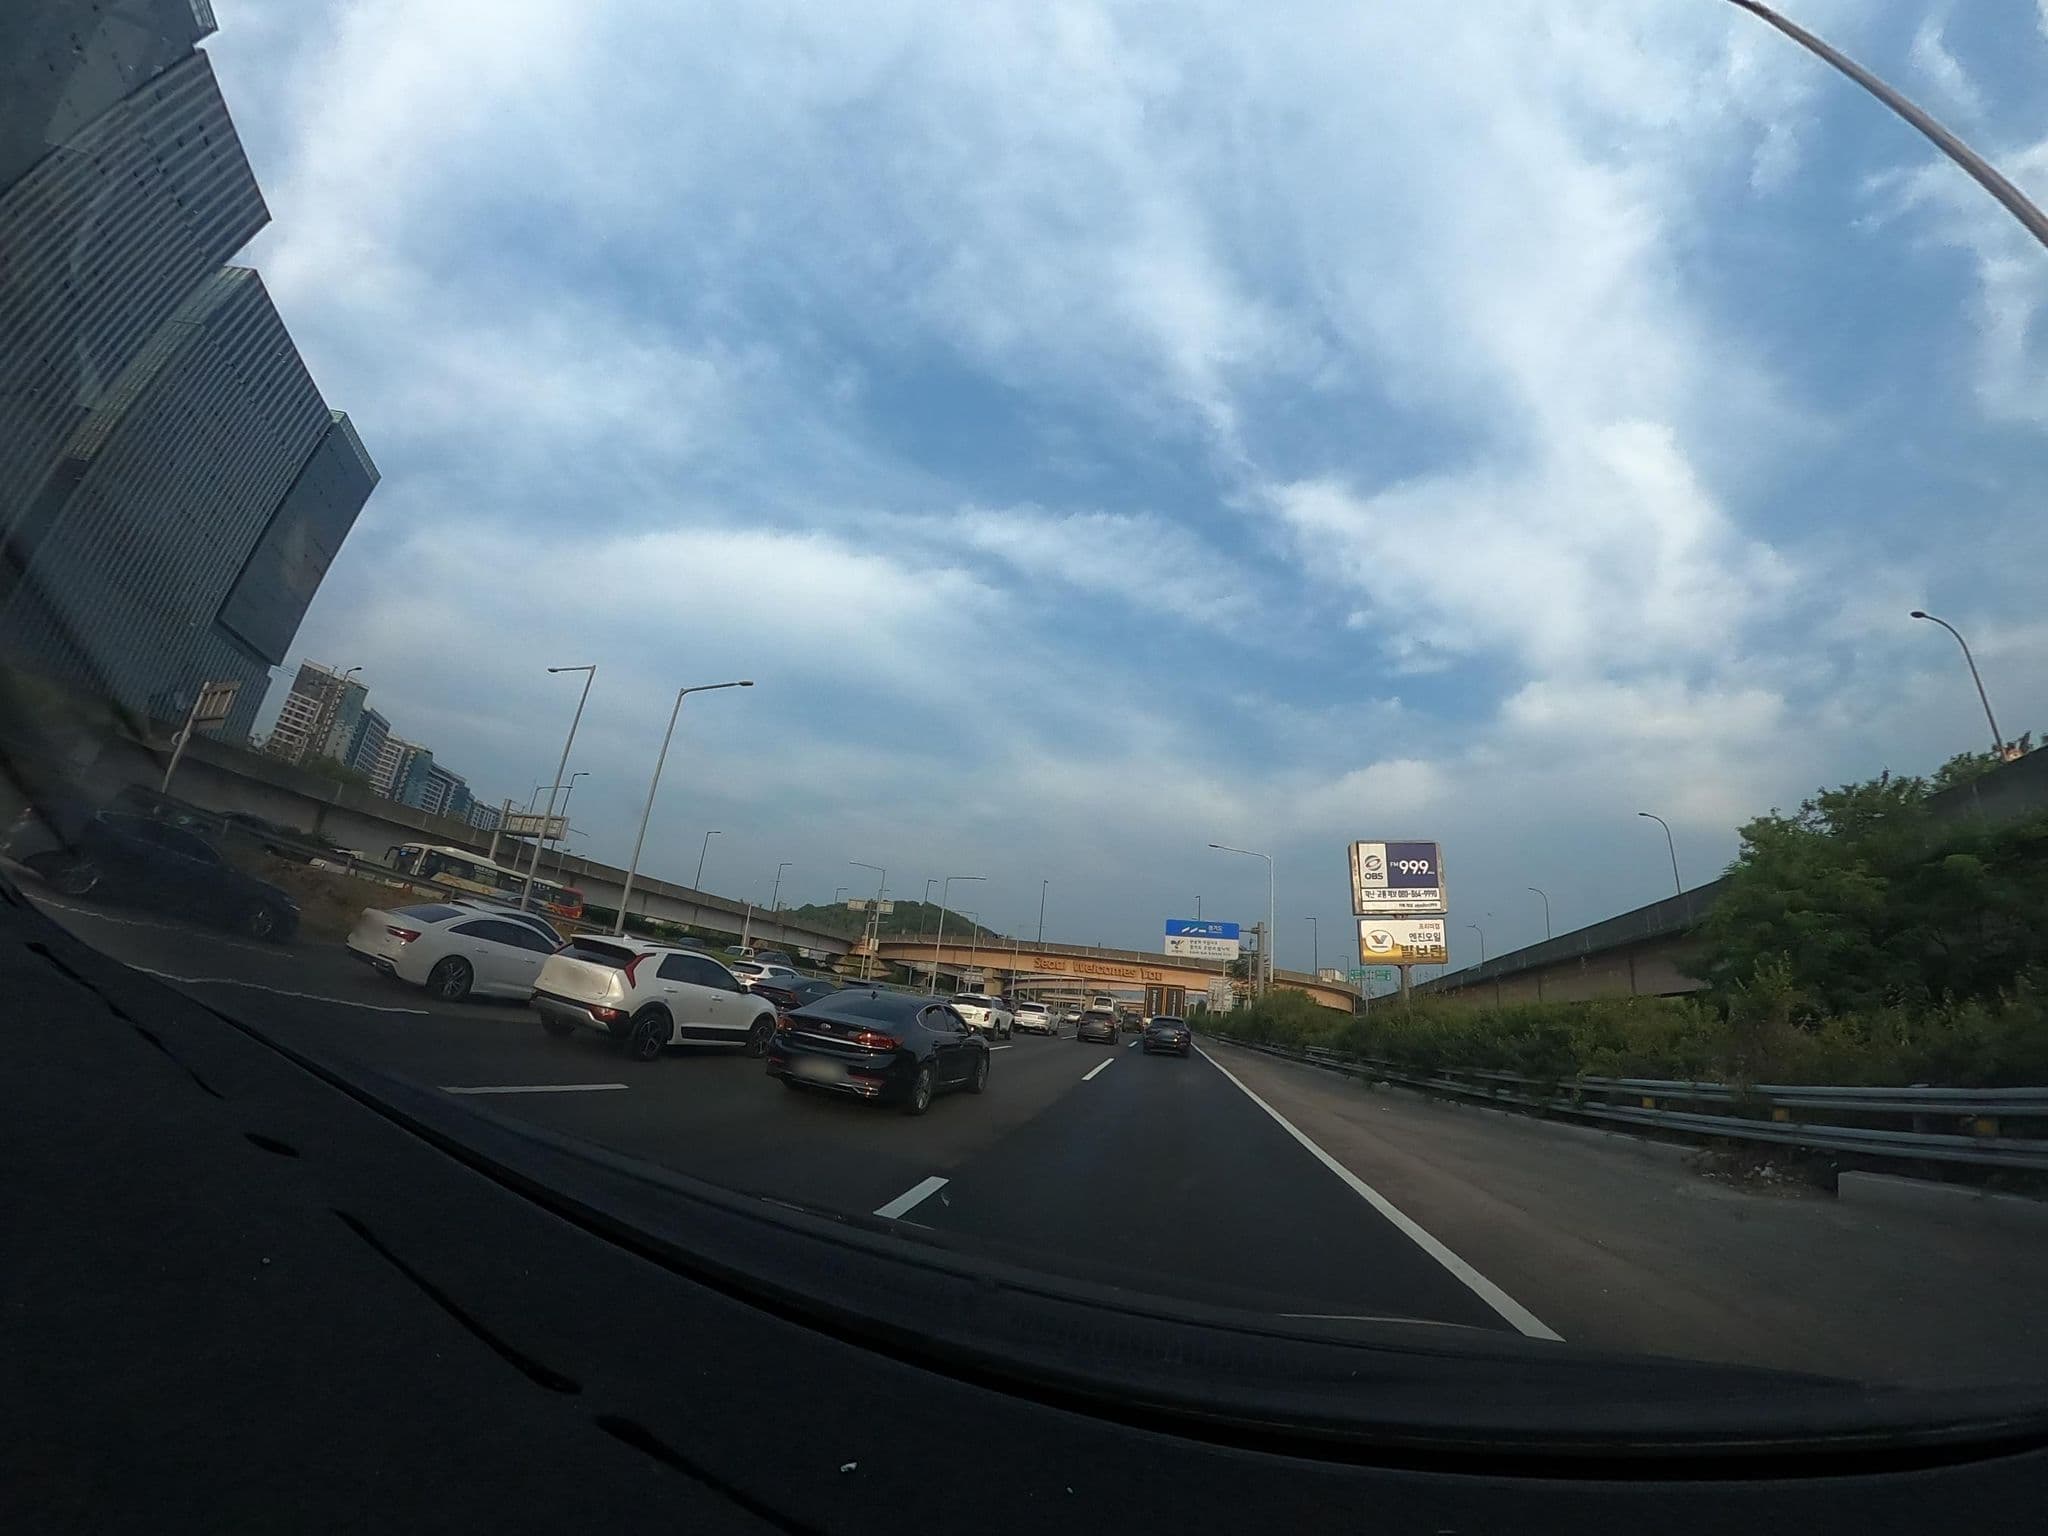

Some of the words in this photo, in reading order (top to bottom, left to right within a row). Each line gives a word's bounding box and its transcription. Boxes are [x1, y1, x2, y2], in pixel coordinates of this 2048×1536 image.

[1399, 860, 1429, 875] 99.9
[1408, 932, 1441, 942] 엔진오일
[1073, 960, 1136, 978] Welcomes
[1140, 967, 1163, 982] You
